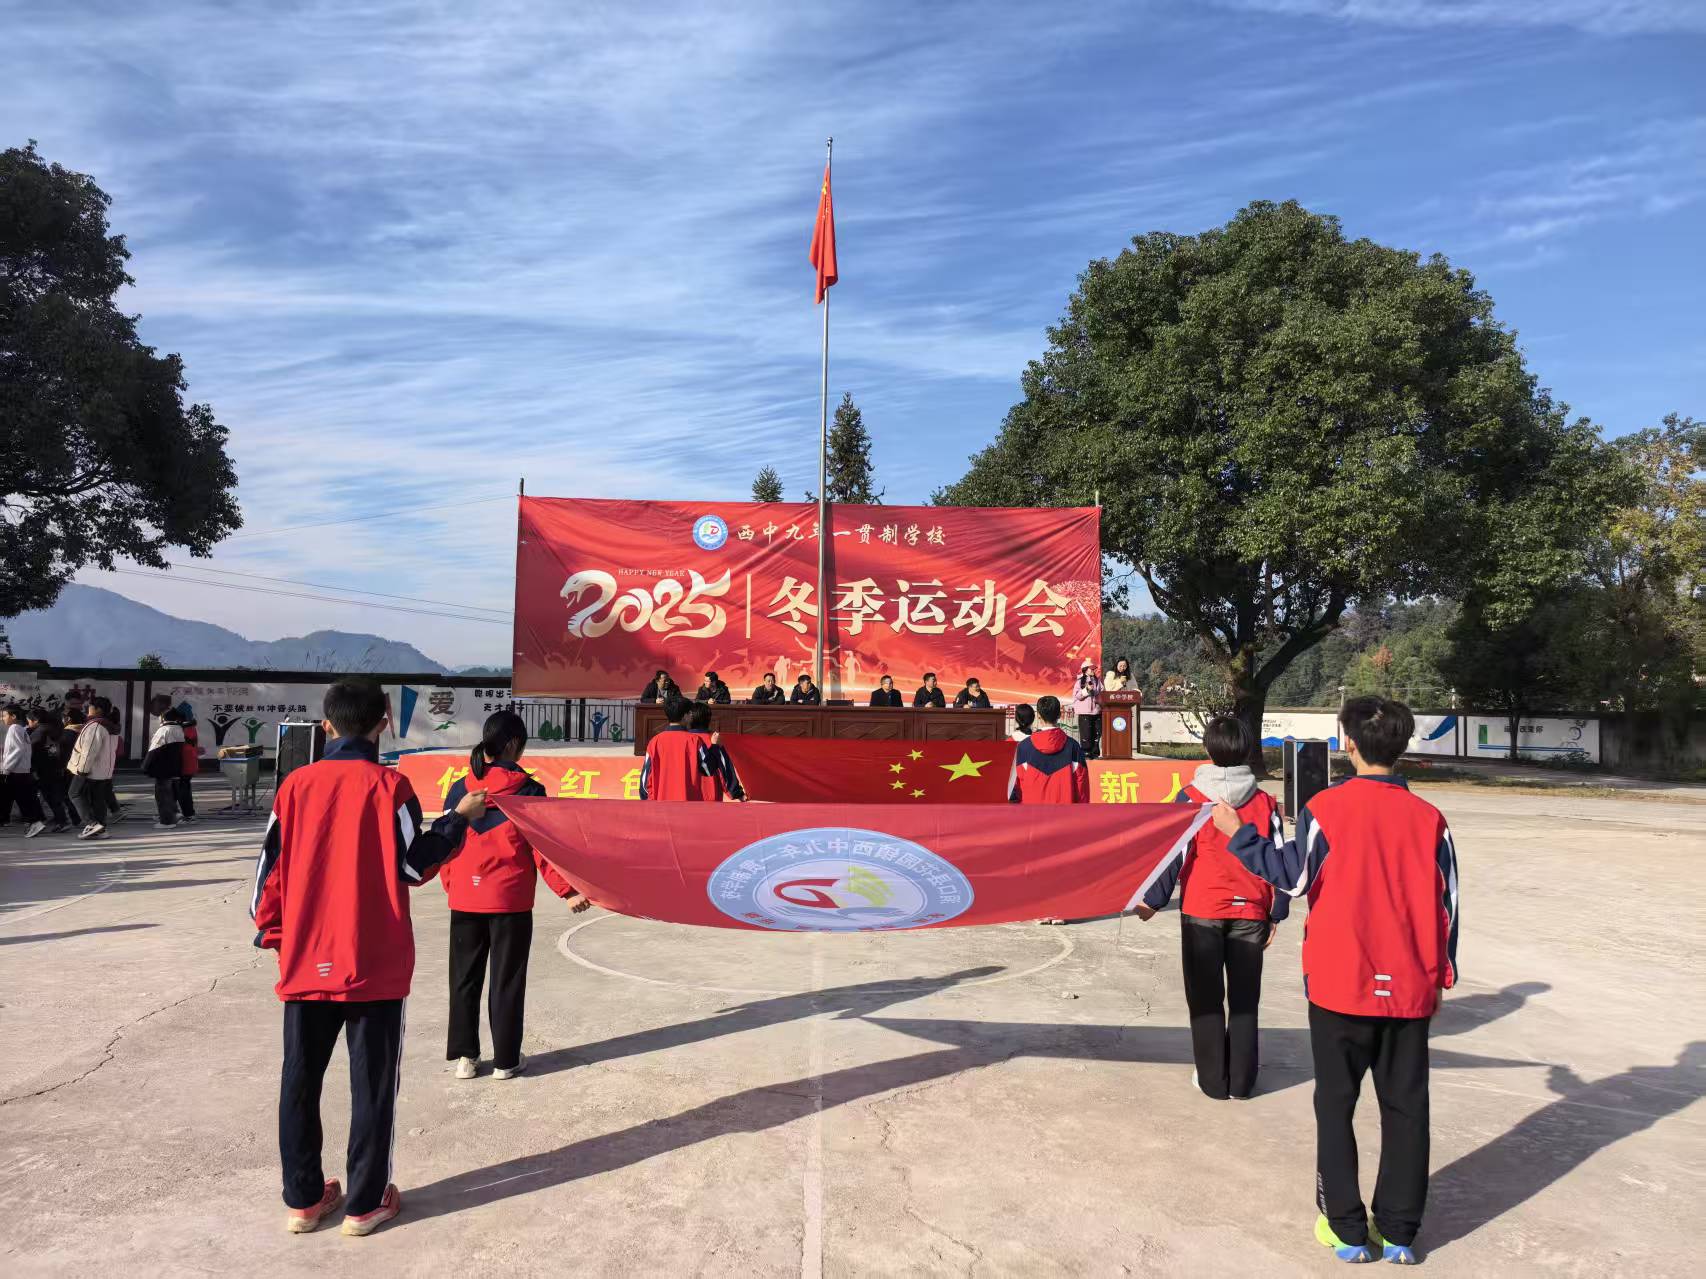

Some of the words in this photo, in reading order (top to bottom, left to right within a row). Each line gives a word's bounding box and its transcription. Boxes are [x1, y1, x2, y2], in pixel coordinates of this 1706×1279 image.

[738, 521, 946, 546] 西中九年一贯制学校
[618, 568, 644, 576] HAPPY
[646, 569, 663, 577] NEW
[665, 569, 685, 577] YEAR
[559, 567, 732, 642] 2025
[766, 577, 1073, 638] 冬季运动会
